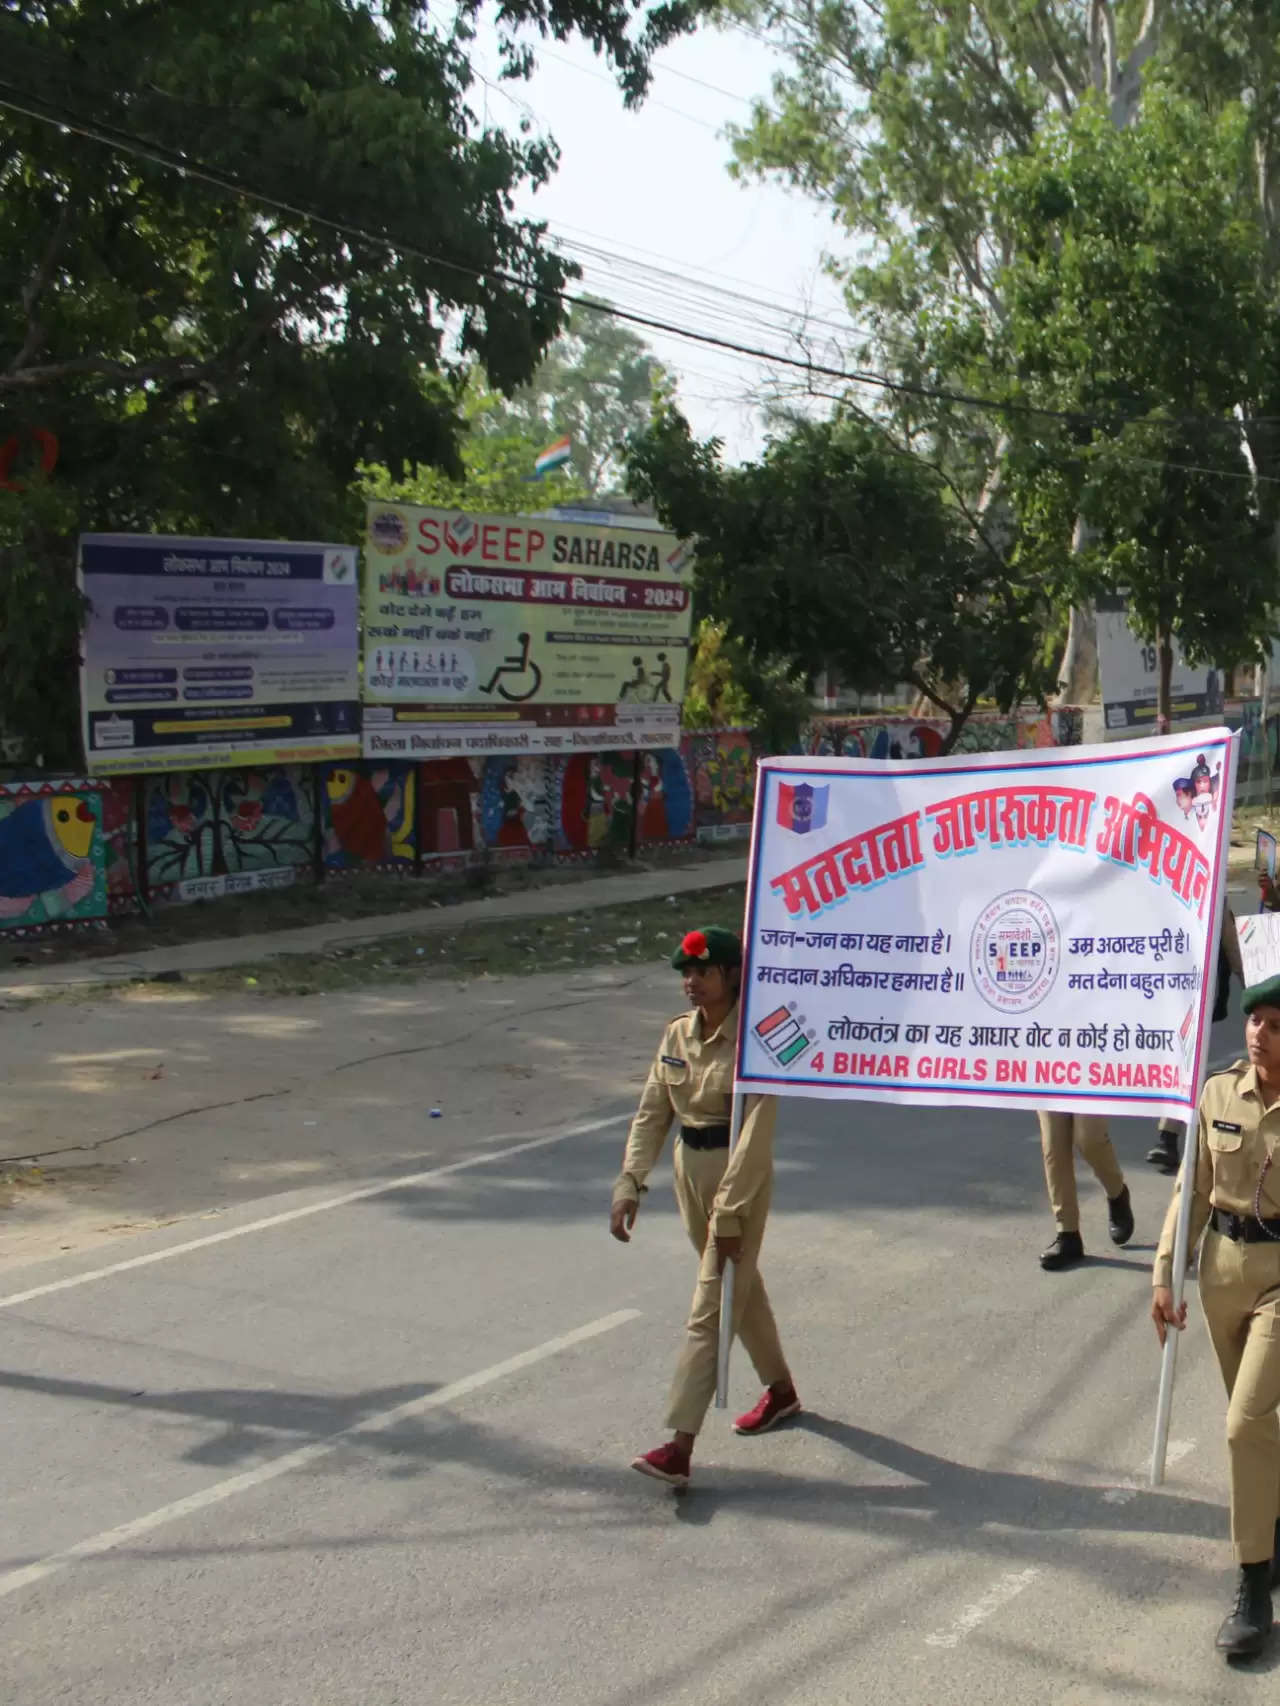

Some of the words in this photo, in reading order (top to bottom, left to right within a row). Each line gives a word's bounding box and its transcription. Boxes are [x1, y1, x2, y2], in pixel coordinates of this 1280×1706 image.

[417, 513, 545, 563] SWEEP
[552, 534, 661, 573] SAHARSA
[450, 568, 525, 597] लोकसभा
[529, 576, 566, 599] आम
[571, 577, 627, 604] निर्वाचन
[644, 587, 685, 607] 2024
[370, 734, 407, 751] जिला
[769, 810, 926, 917] मतदाता
[1096, 790, 1211, 920] अभियान
[760, 928, 838, 949] जन-जन
[839, 932, 865, 951] का
[866, 933, 893, 954] यह
[895, 934, 930, 953] नारा
[1068, 936, 1096, 957] उम्र
[1096, 936, 1147, 955] अठारह
[1149, 928, 1173, 962] पूरी
[757, 965, 820, 987] मतदान
[890, 971, 940, 992] हमारा
[1068, 973, 1096, 991] मत
[1097, 967, 1128, 990] देना
[1129, 972, 1166, 1000] बहुत
[826, 1016, 901, 1043] लोकतंत्र
[905, 1024, 931, 1045] का
[935, 1025, 963, 1048] यह
[1026, 1021, 1053, 1048] वोट
[1058, 1028, 1072, 1048] न
[1076, 1022, 1109, 1052] कोई
[1113, 1023, 1130, 1052] हो
[1135, 1023, 1175, 1052] बेकार
[810, 1051, 825, 1073] 4
[832, 1052, 910, 1078] BIHAR
[916, 1056, 988, 1081] GIRLS
[995, 1059, 1027, 1083] BN
[1034, 1061, 1082, 1085] NCC
[1088, 1062, 1180, 1089] SAHARSA
